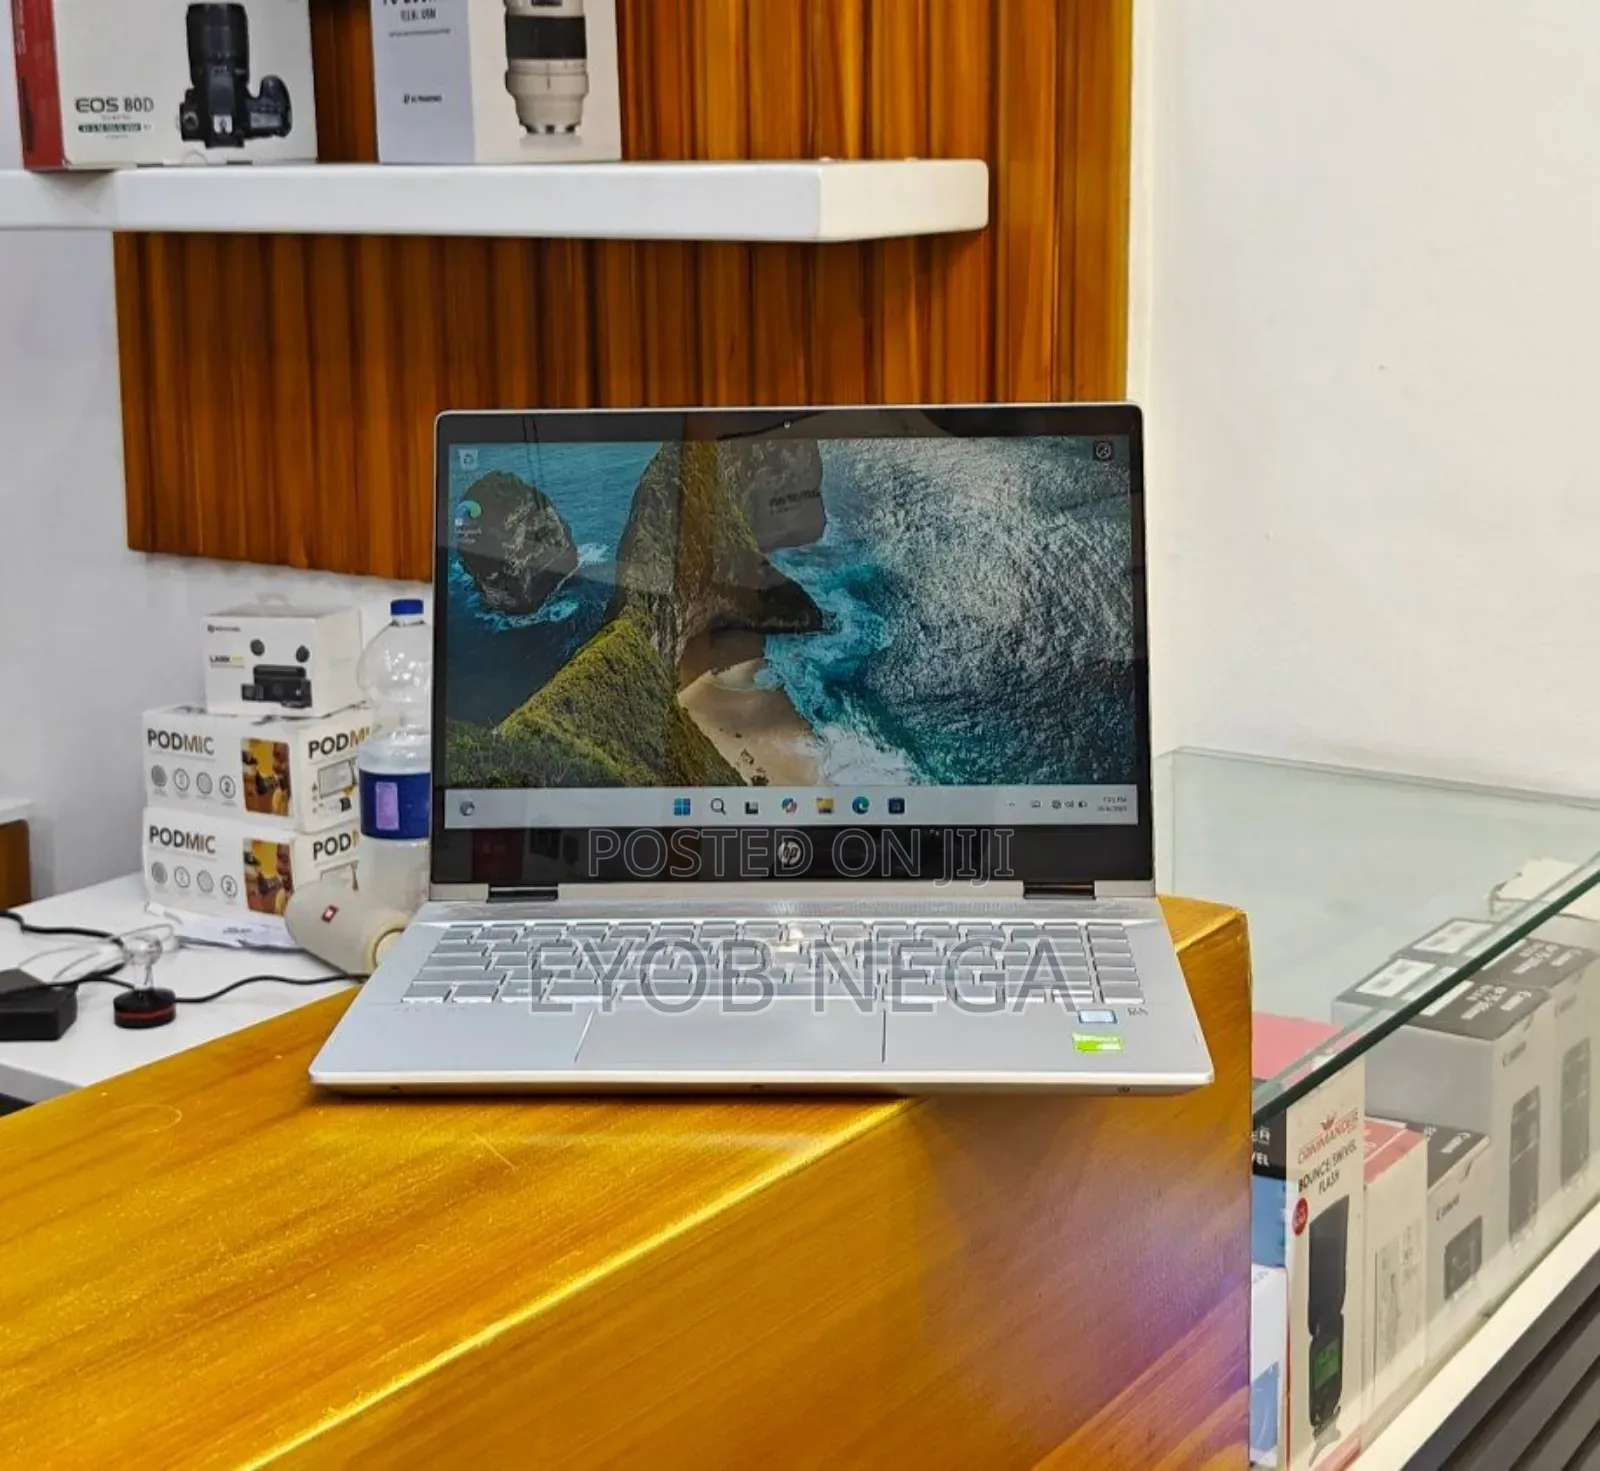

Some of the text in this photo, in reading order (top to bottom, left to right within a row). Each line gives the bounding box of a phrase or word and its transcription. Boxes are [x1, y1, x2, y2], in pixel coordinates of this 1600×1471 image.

[75, 97, 154, 113] EOS 80D
[147, 728, 215, 755] PODMIC
[149, 825, 216, 854] PODMIC
